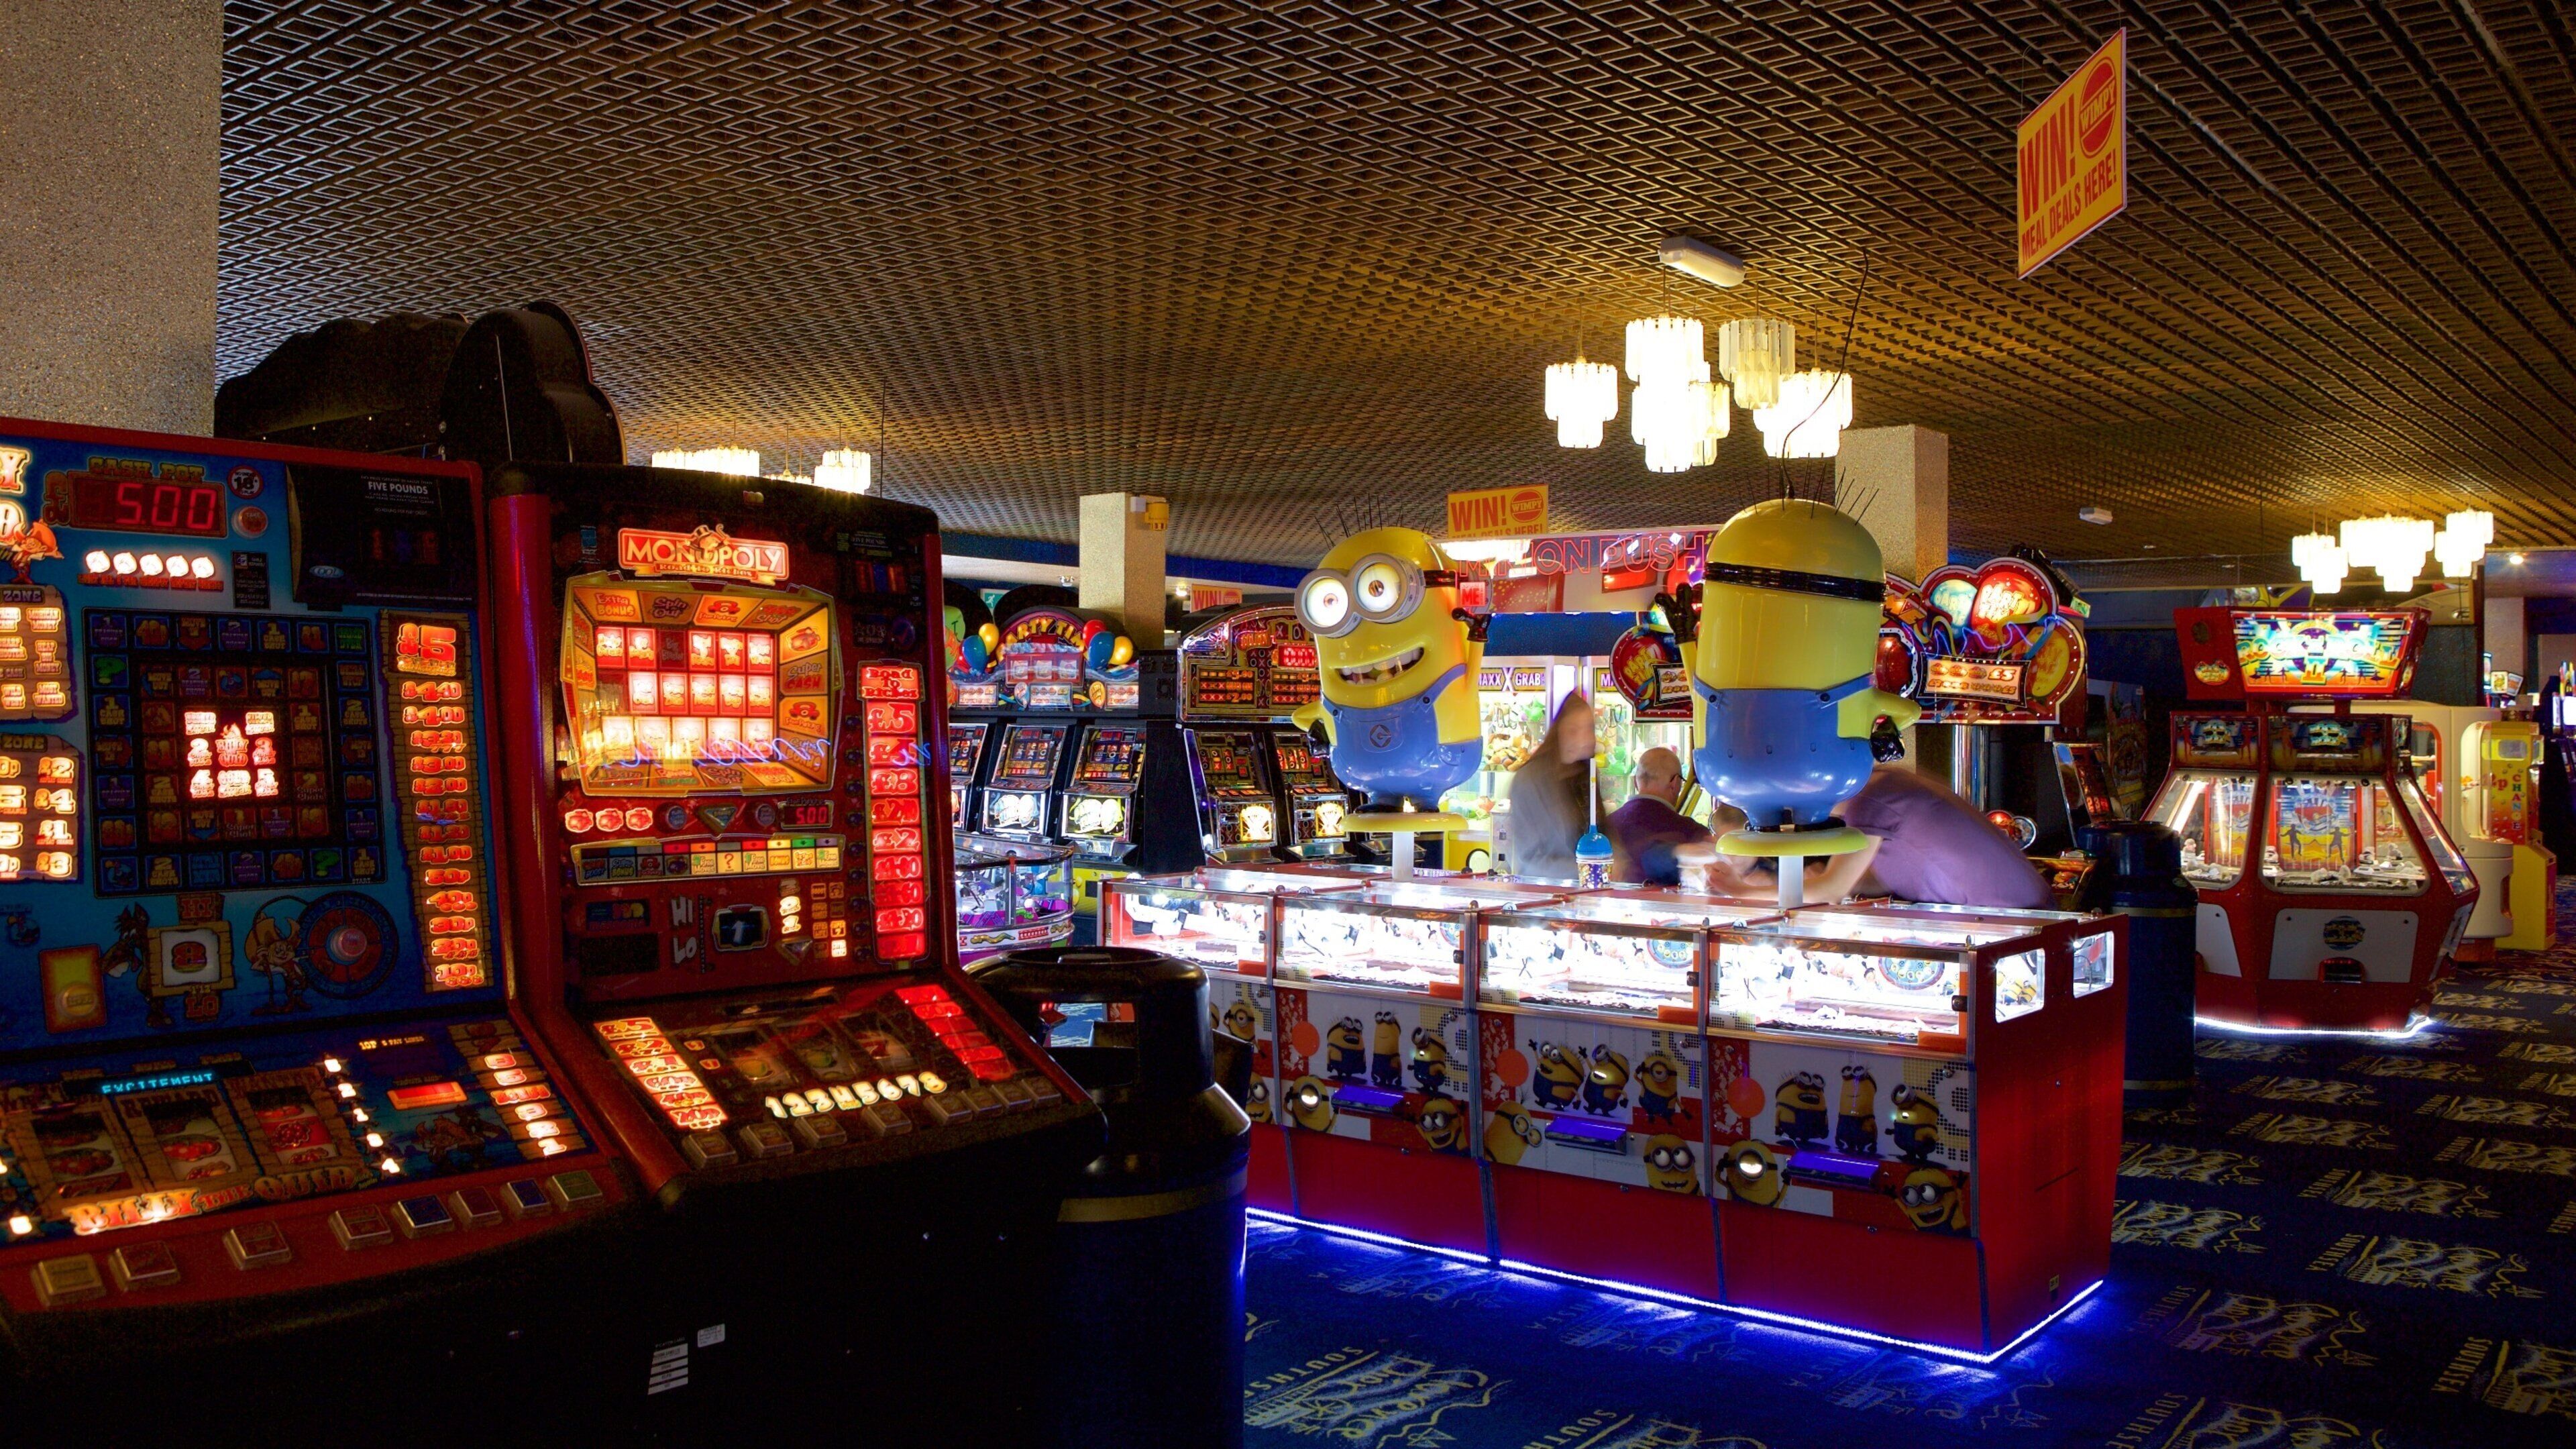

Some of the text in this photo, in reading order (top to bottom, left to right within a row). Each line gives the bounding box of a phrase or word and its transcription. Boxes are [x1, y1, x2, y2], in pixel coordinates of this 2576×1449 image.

[2080, 78, 2115, 133] WIMPY
[2019, 93, 2076, 222] WIN!
[2022, 148, 2116, 264] MEAL DEALS HERE!
[89, 456, 204, 482] CASH POT
[368, 481, 429, 495] FIVE POUNDS
[115, 482, 217, 530] 5.00
[1450, 494, 1507, 532] WIN!
[1511, 500, 1542, 513] WIMPY
[626, 537, 782, 572] MONOPOLY
[1600, 535, 1705, 573] PUSH
[3, 590, 42, 602] ZONE
[595, 592, 631, 605] Extra
[653, 596, 690, 610] Spin
[1462, 588, 1479, 603] ME
[596, 604, 636, 618] BONUS
[653, 607, 681, 619] Out
[397, 623, 456, 662] £5
[788, 663, 822, 678] Super
[1515, 674, 1541, 686] GRAB
[1988, 668, 2017, 682] £5
[785, 675, 821, 690] CASH
[402, 706, 465, 727] £4.00
[868, 702, 916, 734] £5
[3, 739, 44, 750] ZONE
[215, 739, 249, 753] BILLY
[410, 756, 467, 774] £3.00
[34, 789, 76, 814] £4
[2512, 774, 2522, 830] CHANGE
[873, 827, 920, 852] £2
[36, 852, 72, 877] £3
[693, 864, 716, 874] Moves
[699, 857, 716, 867] Free
[769, 855, 790, 865] BONUS
[180, 898, 212, 918] HI
[672, 896, 693, 926] HI
[429, 915, 476, 934] 30p
[431, 937, 477, 956] 20p
[673, 936, 698, 965] LO
[435, 963, 477, 982] 10p
[186, 994, 218, 1017] LO
[101, 1071, 215, 1095] EXCITEMENT
[65, 1187, 201, 1236] BILLY
[2305, 1232, 2366, 1272] SOUTHSEA
[2430, 1336, 2493, 1394] SOUTHSEA
